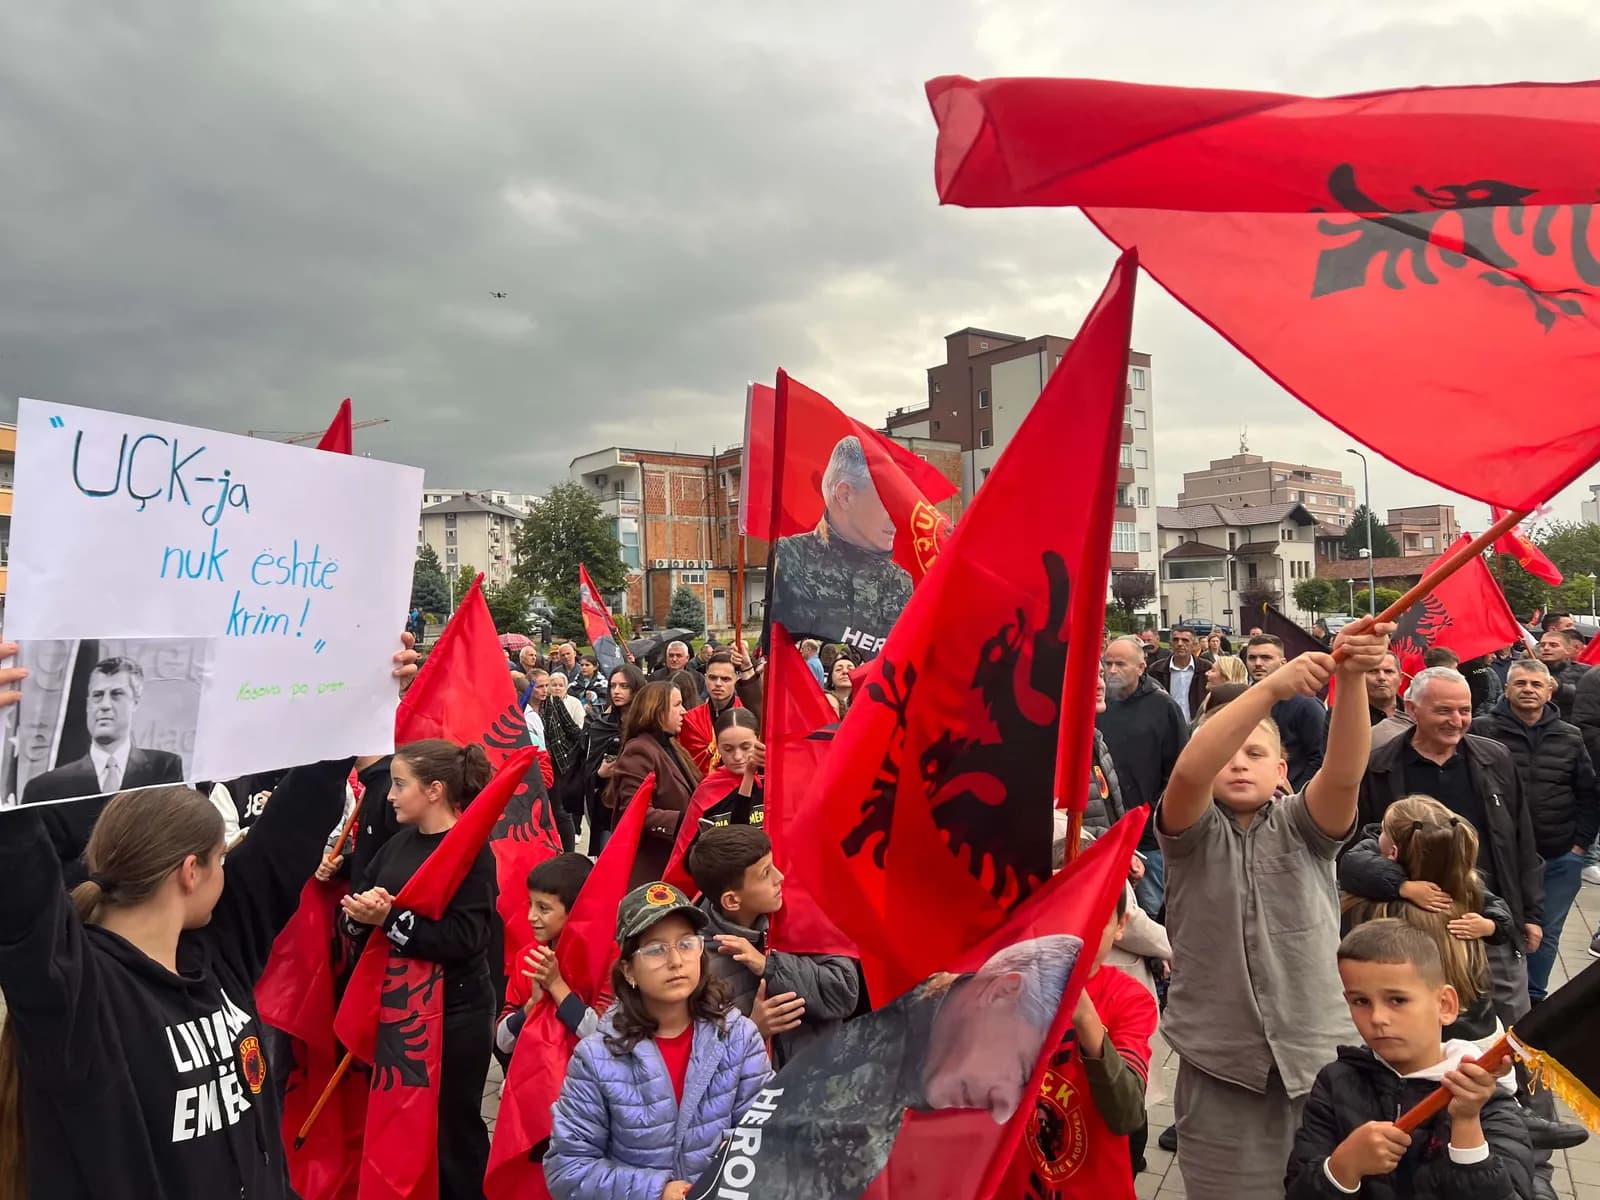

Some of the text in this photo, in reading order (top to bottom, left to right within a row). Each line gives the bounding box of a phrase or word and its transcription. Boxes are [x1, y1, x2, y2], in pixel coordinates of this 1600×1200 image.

[159, 527, 339, 590] nuk është
[1040, 1071, 1075, 1109] ÇK
